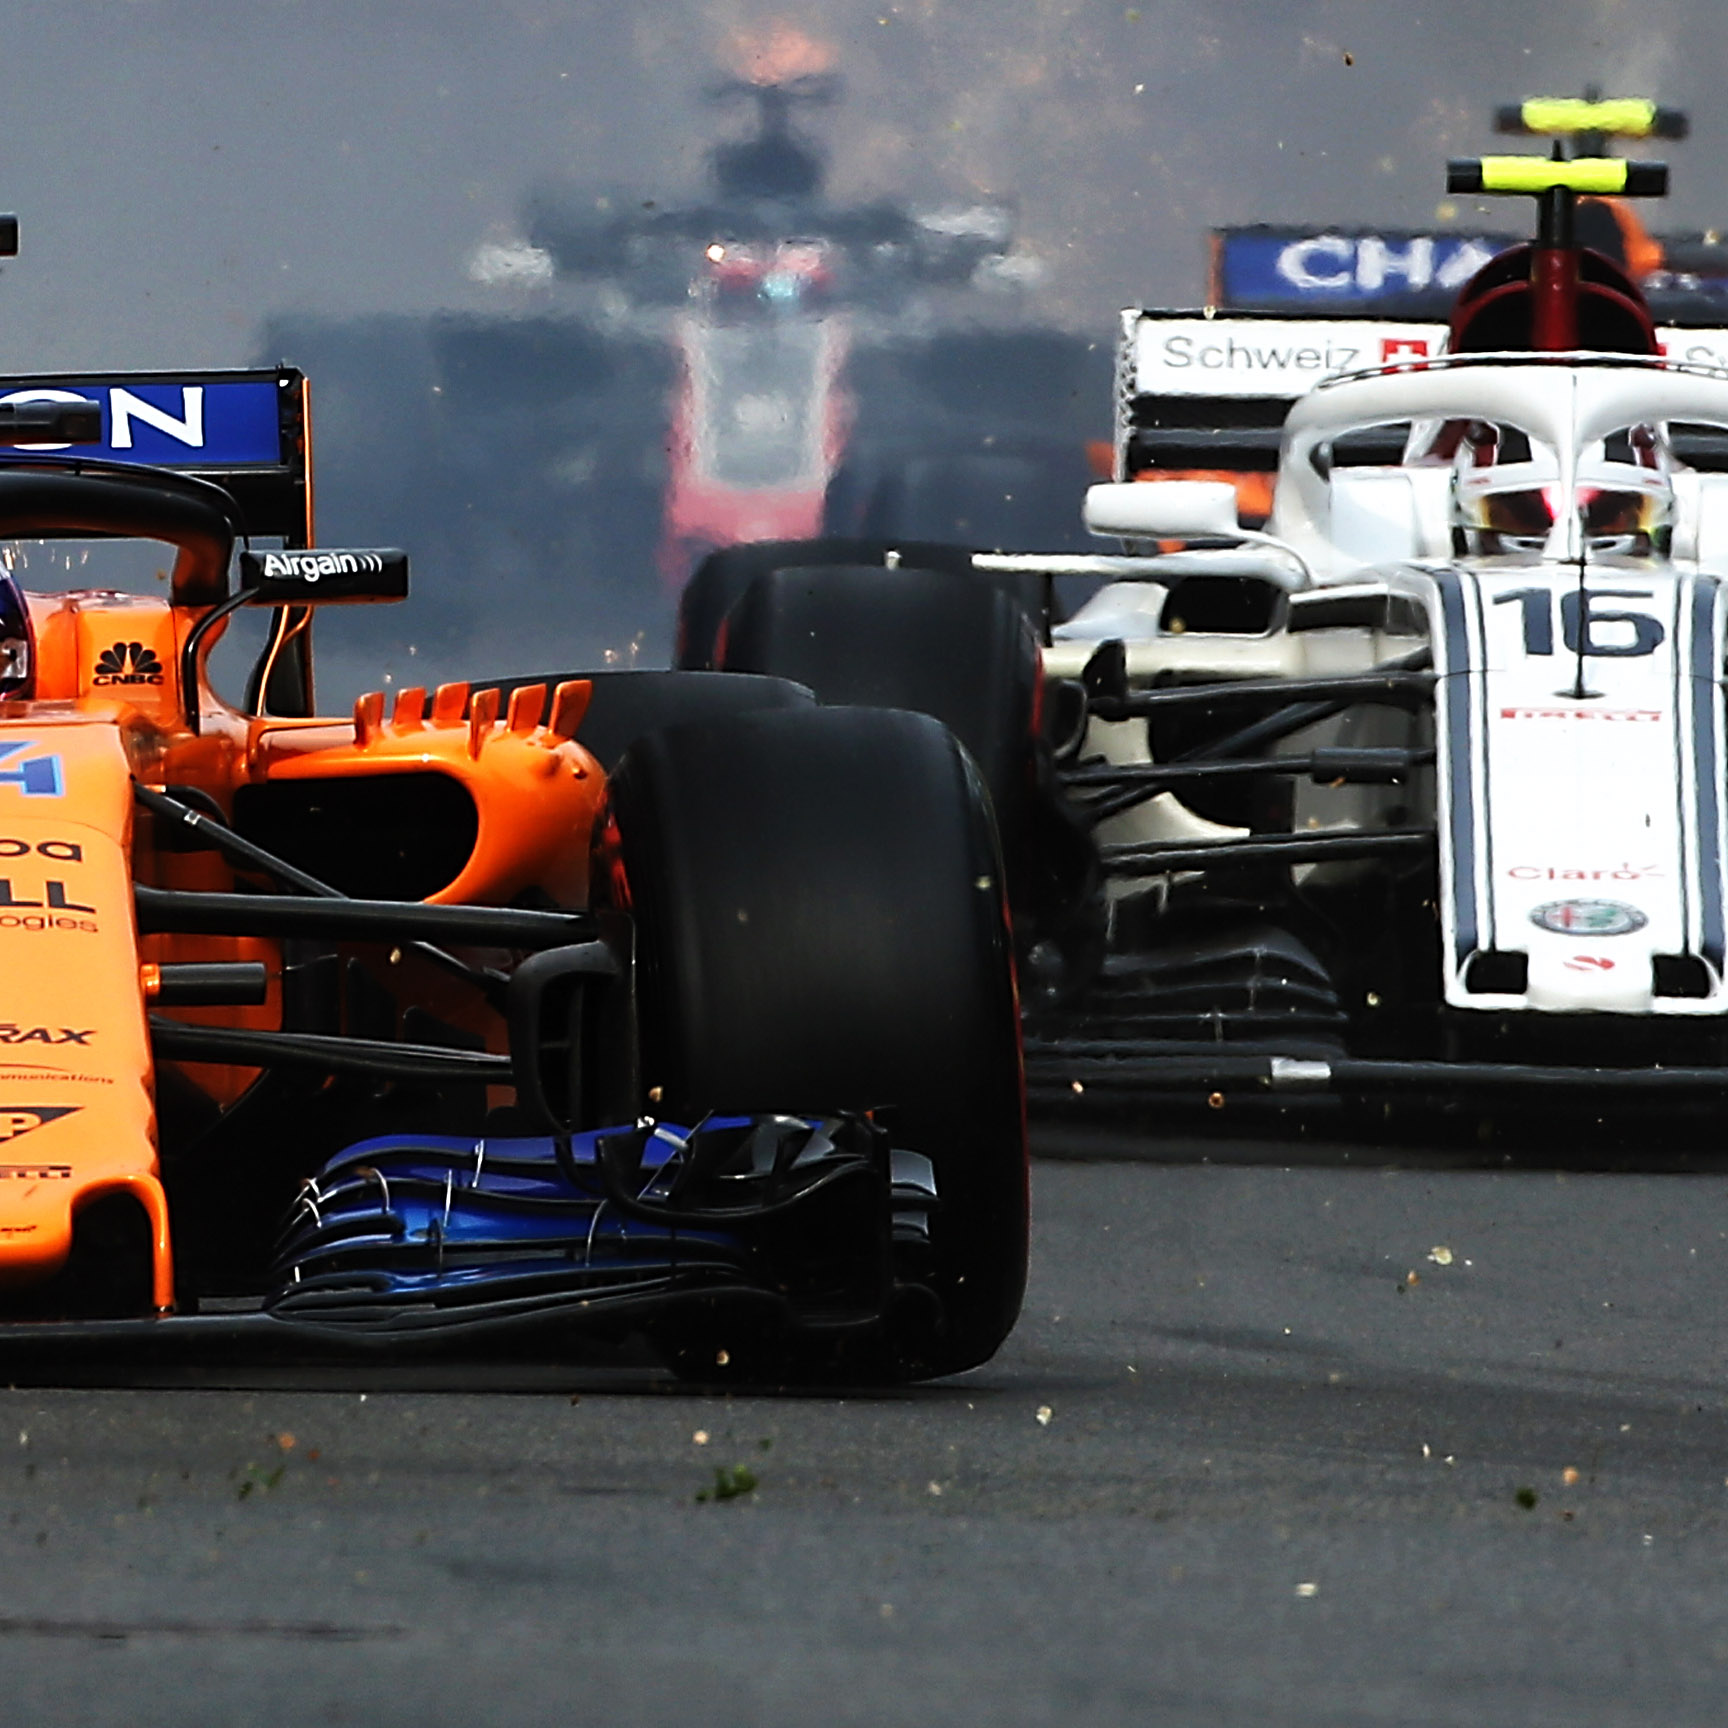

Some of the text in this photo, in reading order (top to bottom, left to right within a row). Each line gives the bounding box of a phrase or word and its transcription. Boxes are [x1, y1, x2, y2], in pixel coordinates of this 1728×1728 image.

[1163, 335, 1361, 371] Schweiz
[263, 551, 360, 583] Airgain
[1492, 587, 1665, 657] 16
[93, 674, 165, 686] CNBC
